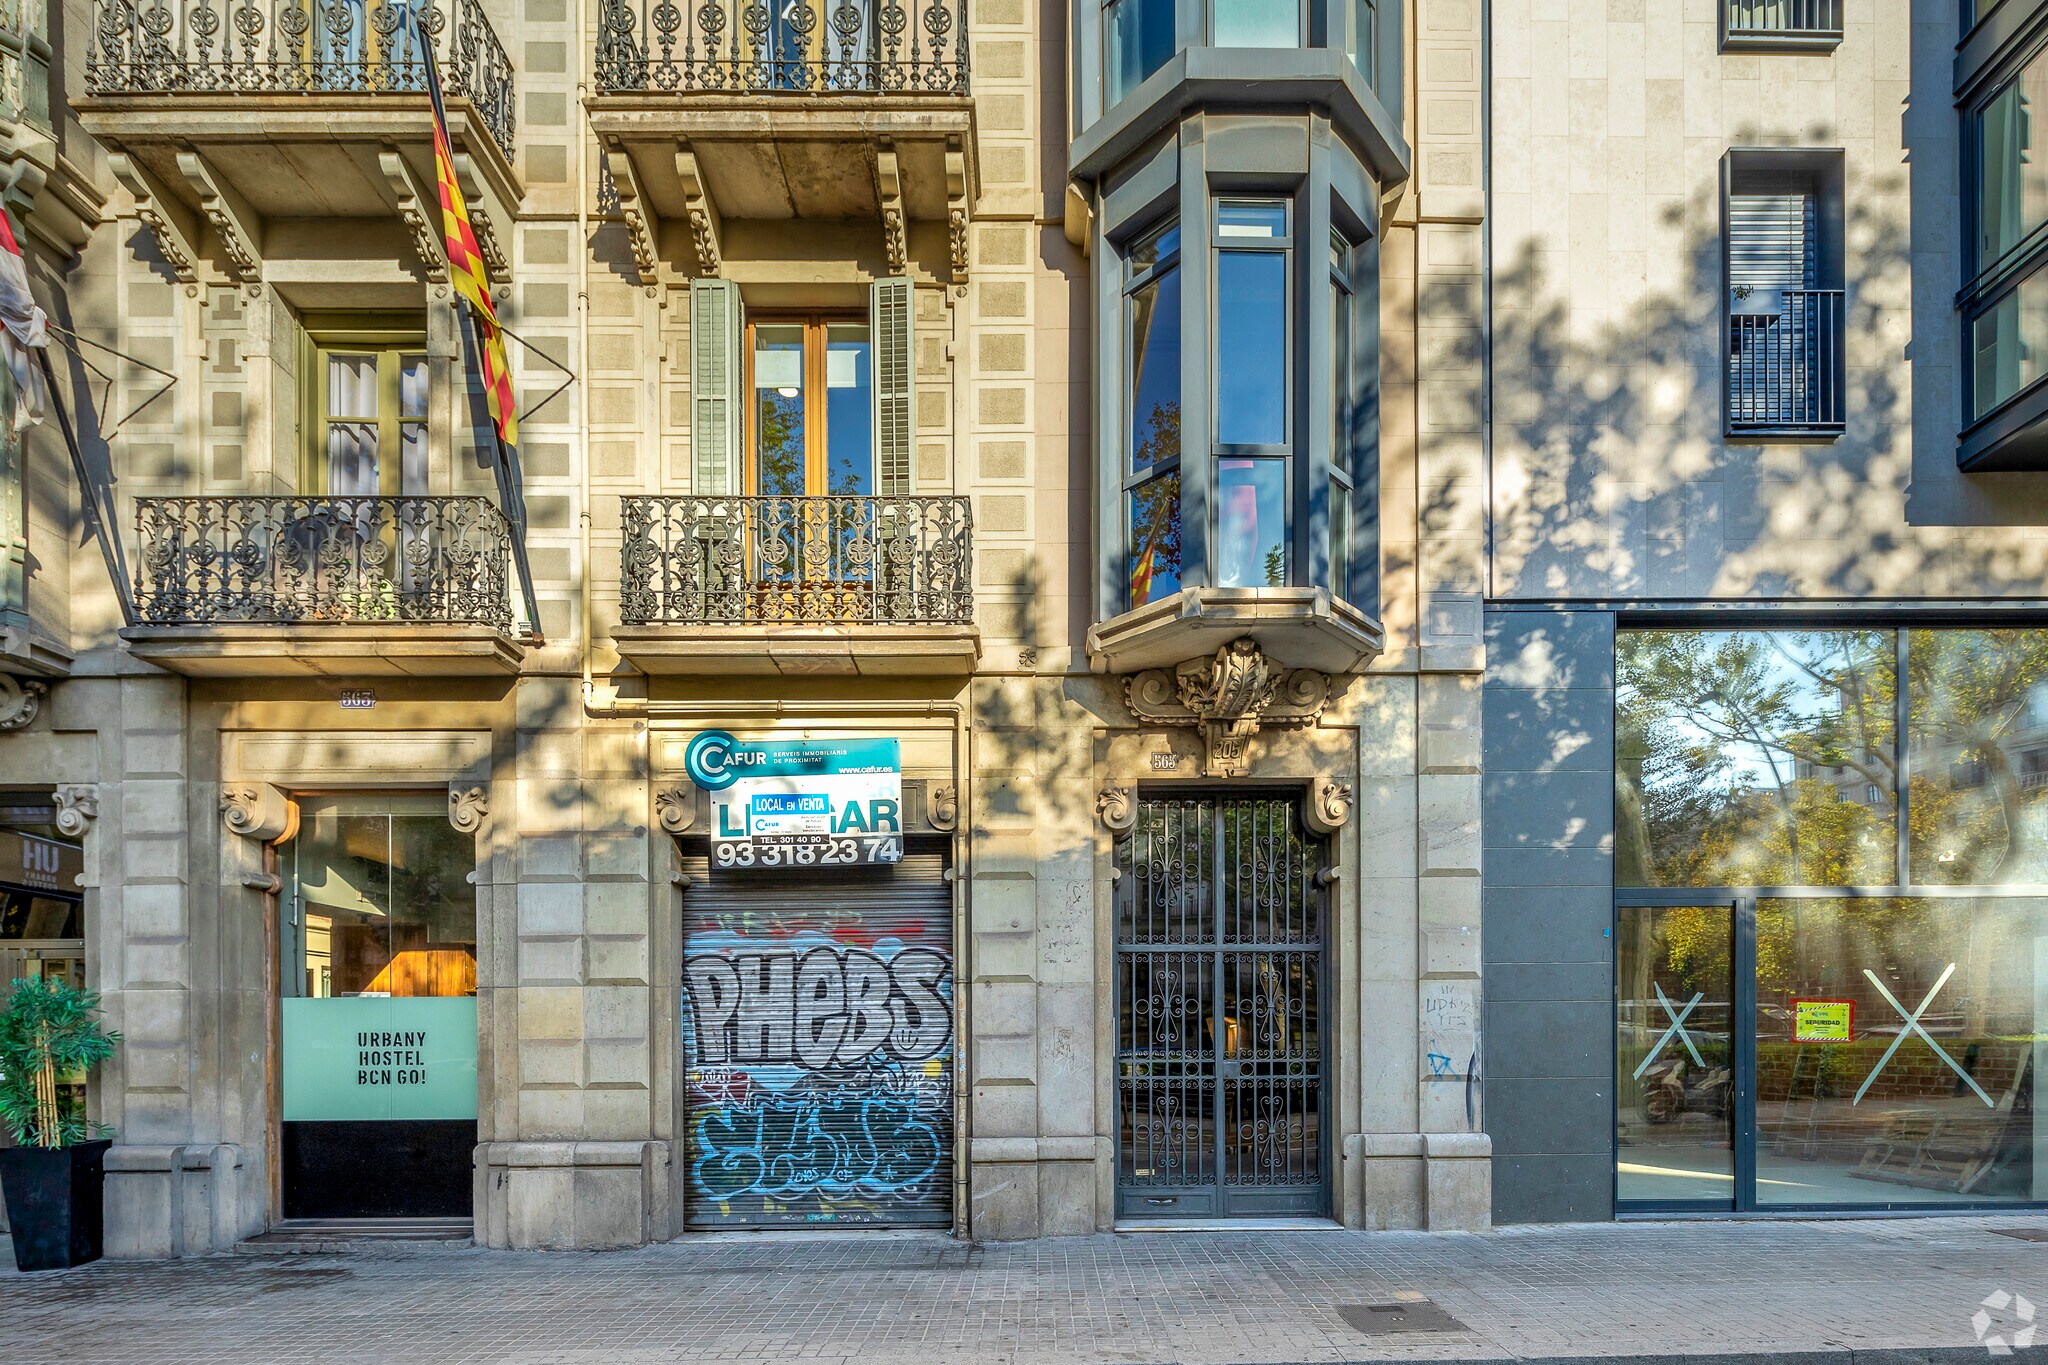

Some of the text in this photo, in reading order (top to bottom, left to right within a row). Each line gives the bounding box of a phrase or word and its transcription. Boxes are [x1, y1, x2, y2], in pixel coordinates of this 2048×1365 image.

[342, 691, 371, 706] 563
[802, 749, 848, 757] IMMOBILIARIS
[1213, 741, 1241, 759] 205
[700, 745, 767, 774] CAFUR
[1153, 754, 1176, 769] 565
[838, 766, 893, 774] www.cafur.es
[756, 797, 825, 812] LOCAL EN VENTA
[760, 836, 777, 844] TEL.
[780, 836, 794, 844] 301
[716, 837, 900, 867] 93 318 23 74
[357, 1031, 426, 1047] URBANY
[359, 1050, 425, 1066] HOSTEL
[357, 1069, 426, 1085] BCN GO!
